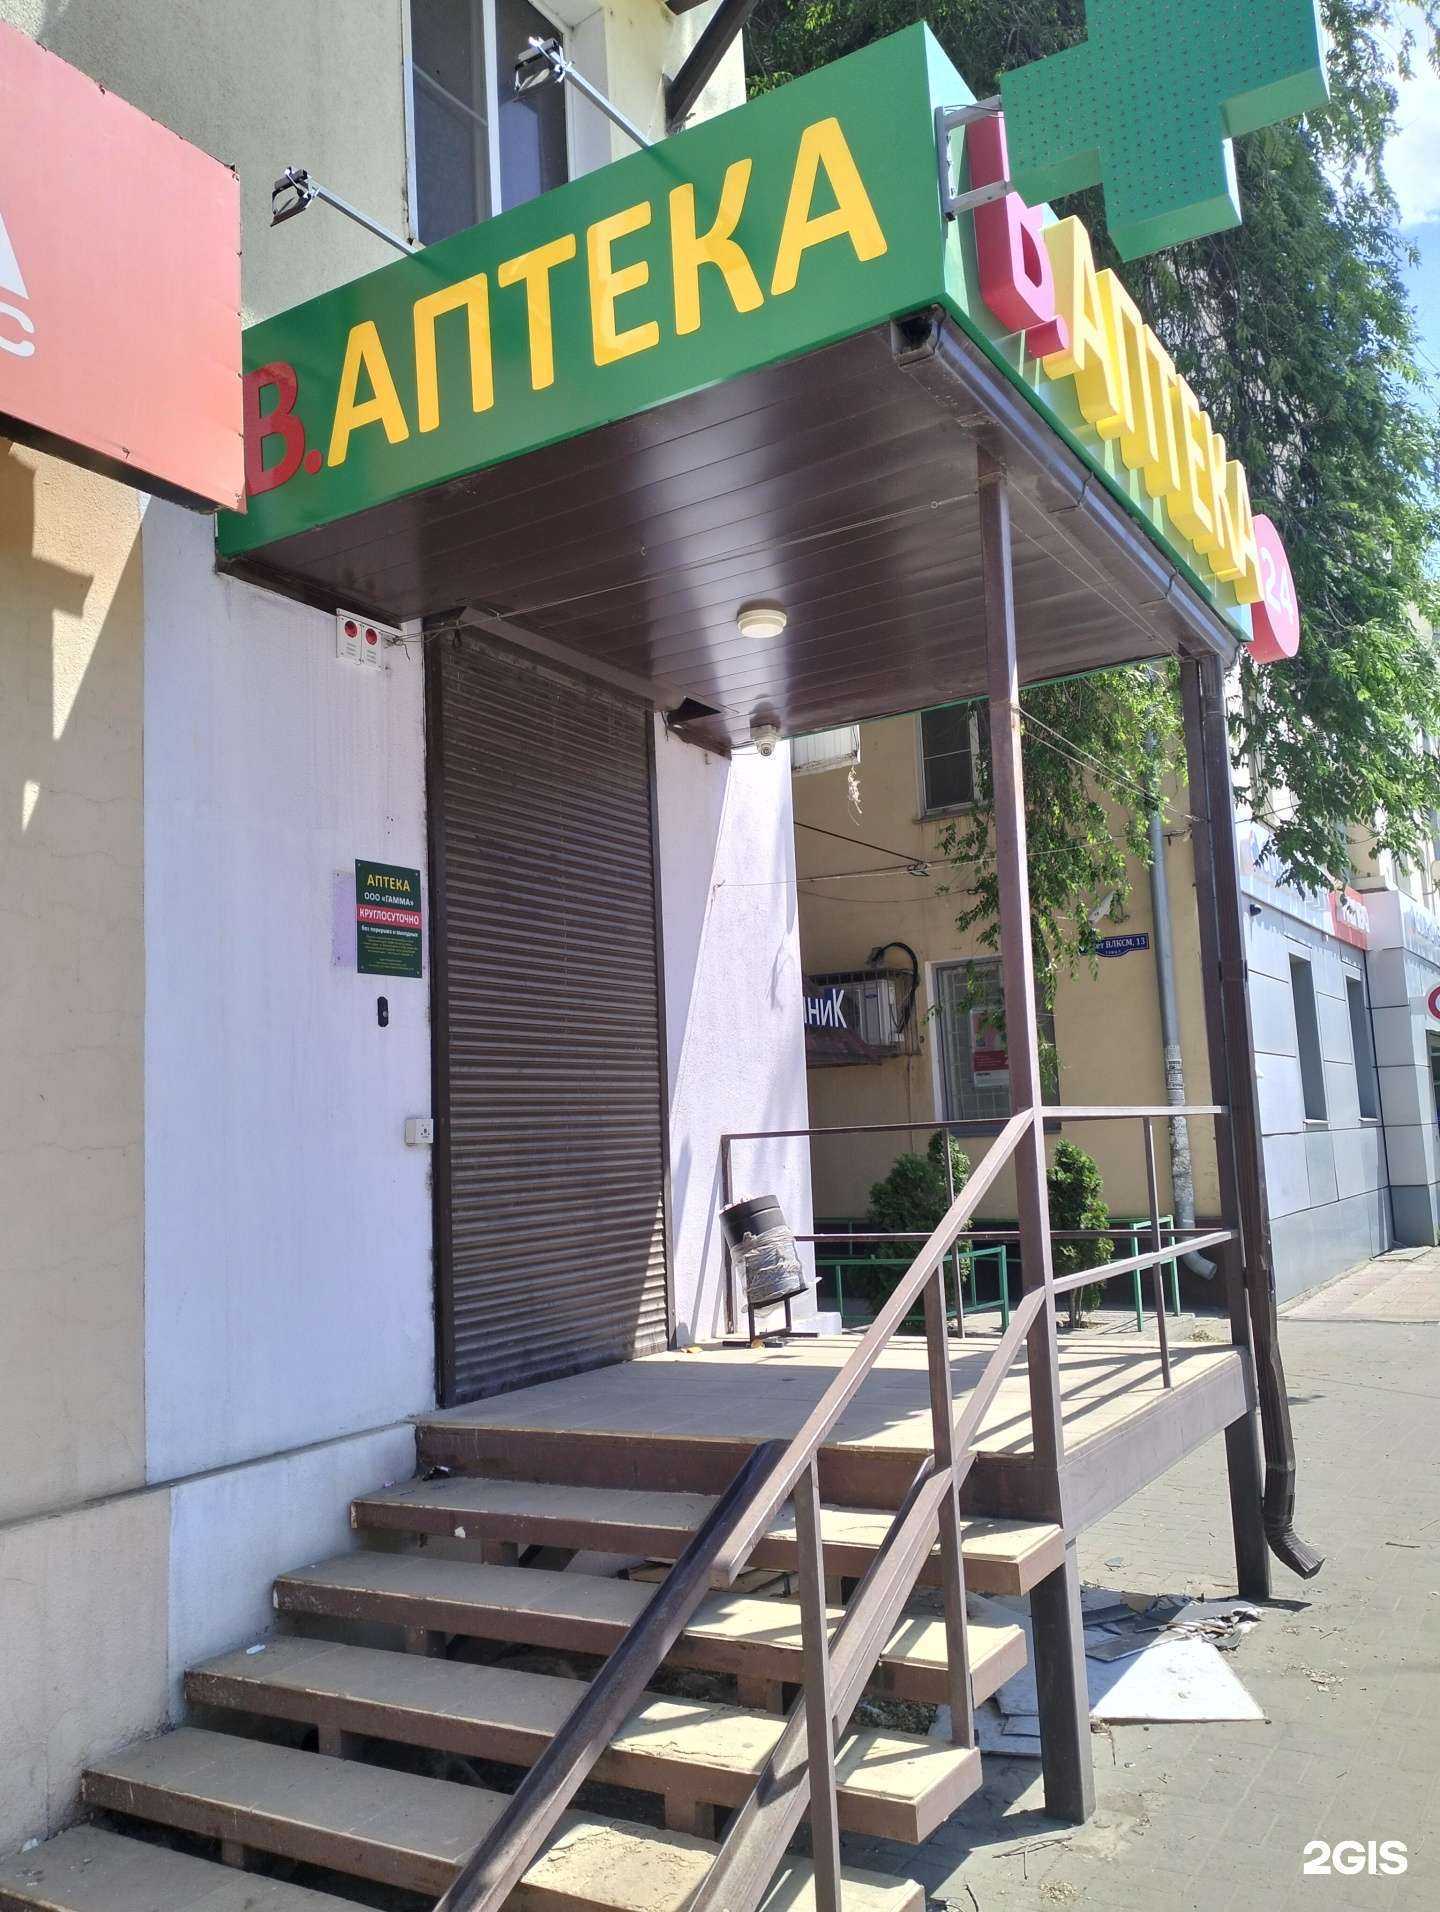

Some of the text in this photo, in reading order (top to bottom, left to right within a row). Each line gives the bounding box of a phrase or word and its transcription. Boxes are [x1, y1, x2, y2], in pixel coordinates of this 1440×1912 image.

[1260, 546, 1294, 625] 24
[367, 874, 410, 891] АПТЕКА
[364, 892, 380, 901] ООО
[360, 908, 419, 925] КРУГЛОСУТОЧНО
